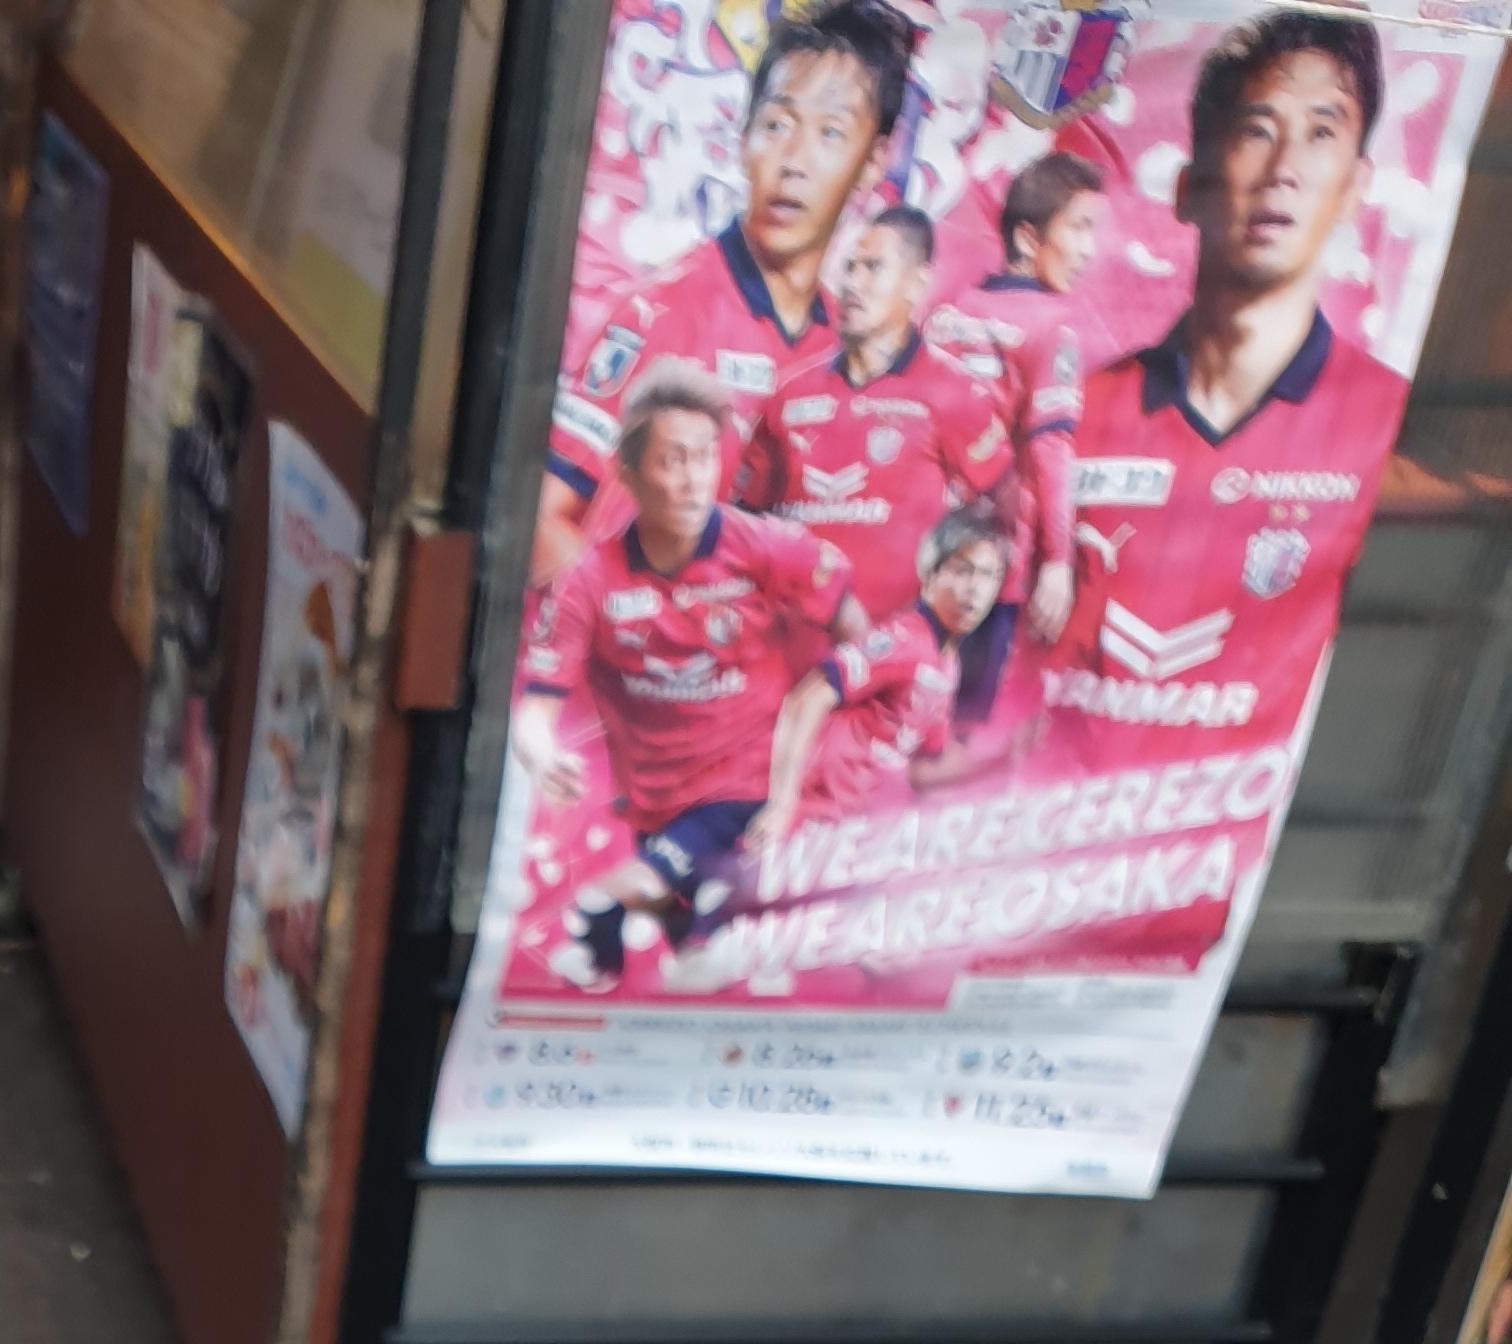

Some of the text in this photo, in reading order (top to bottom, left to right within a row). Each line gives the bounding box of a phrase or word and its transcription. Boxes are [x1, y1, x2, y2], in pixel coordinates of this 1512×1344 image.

[1040, 666, 1260, 728] YANMAR
[756, 745, 1287, 903] WE ARE CEREZO
[849, 877, 984, 958] ARE
[986, 834, 1237, 942] OSAKA
